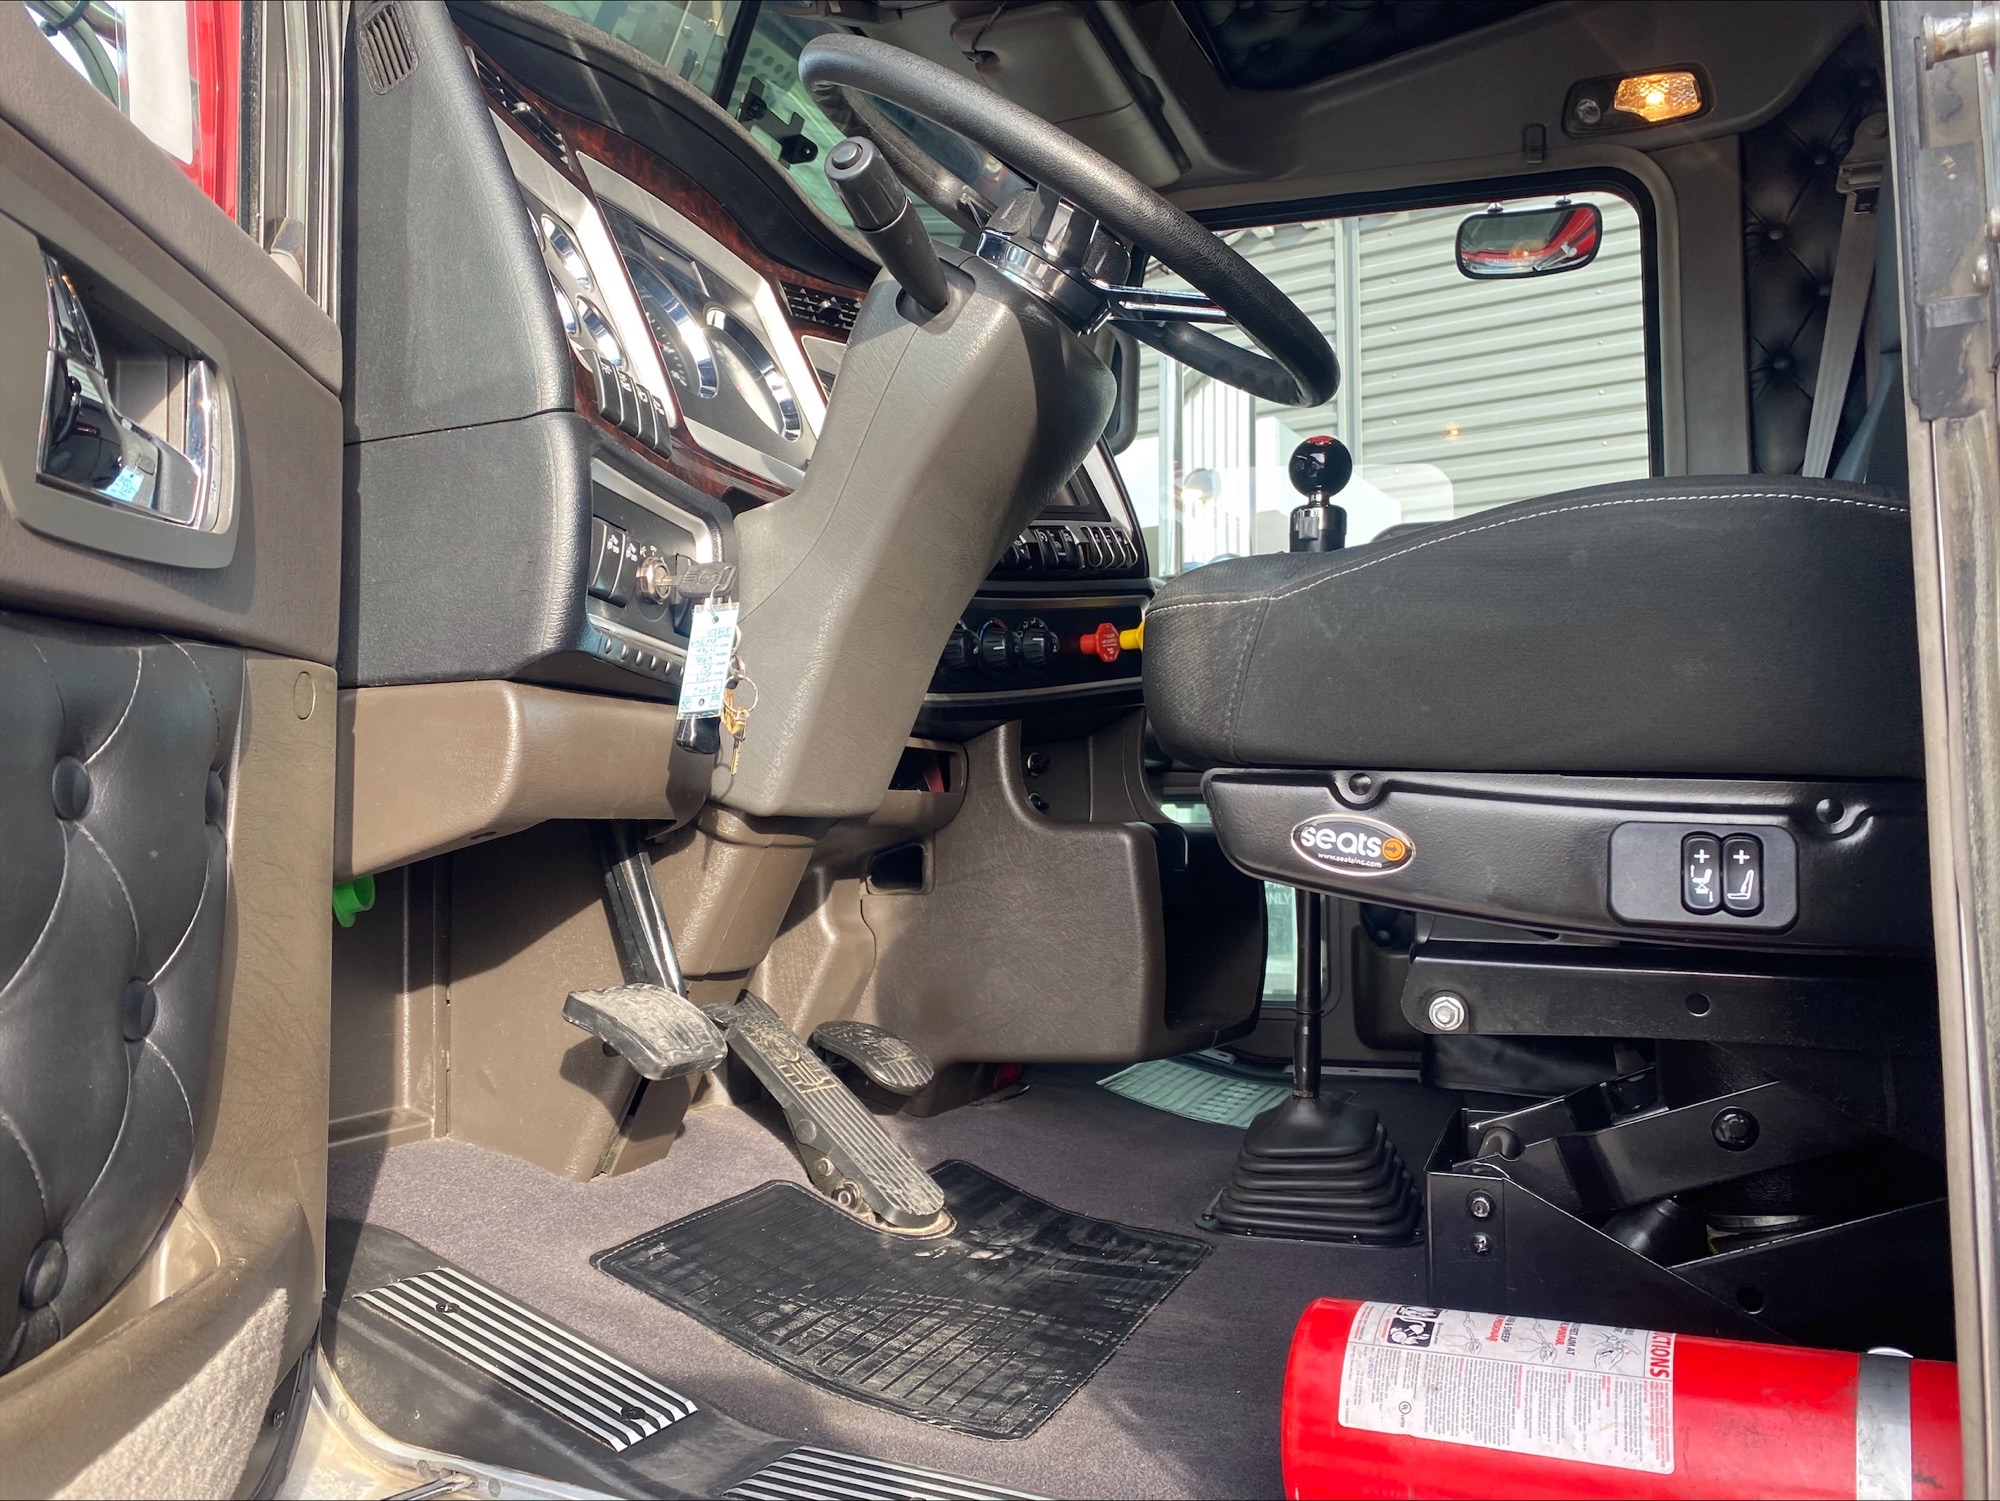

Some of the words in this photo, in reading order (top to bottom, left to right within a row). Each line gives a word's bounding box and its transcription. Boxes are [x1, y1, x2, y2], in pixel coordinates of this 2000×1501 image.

[1301, 827, 1382, 858] seats
[1318, 852, 1382, 868] www.seatsinc.com
[1267, 892, 1291, 905] NLY
